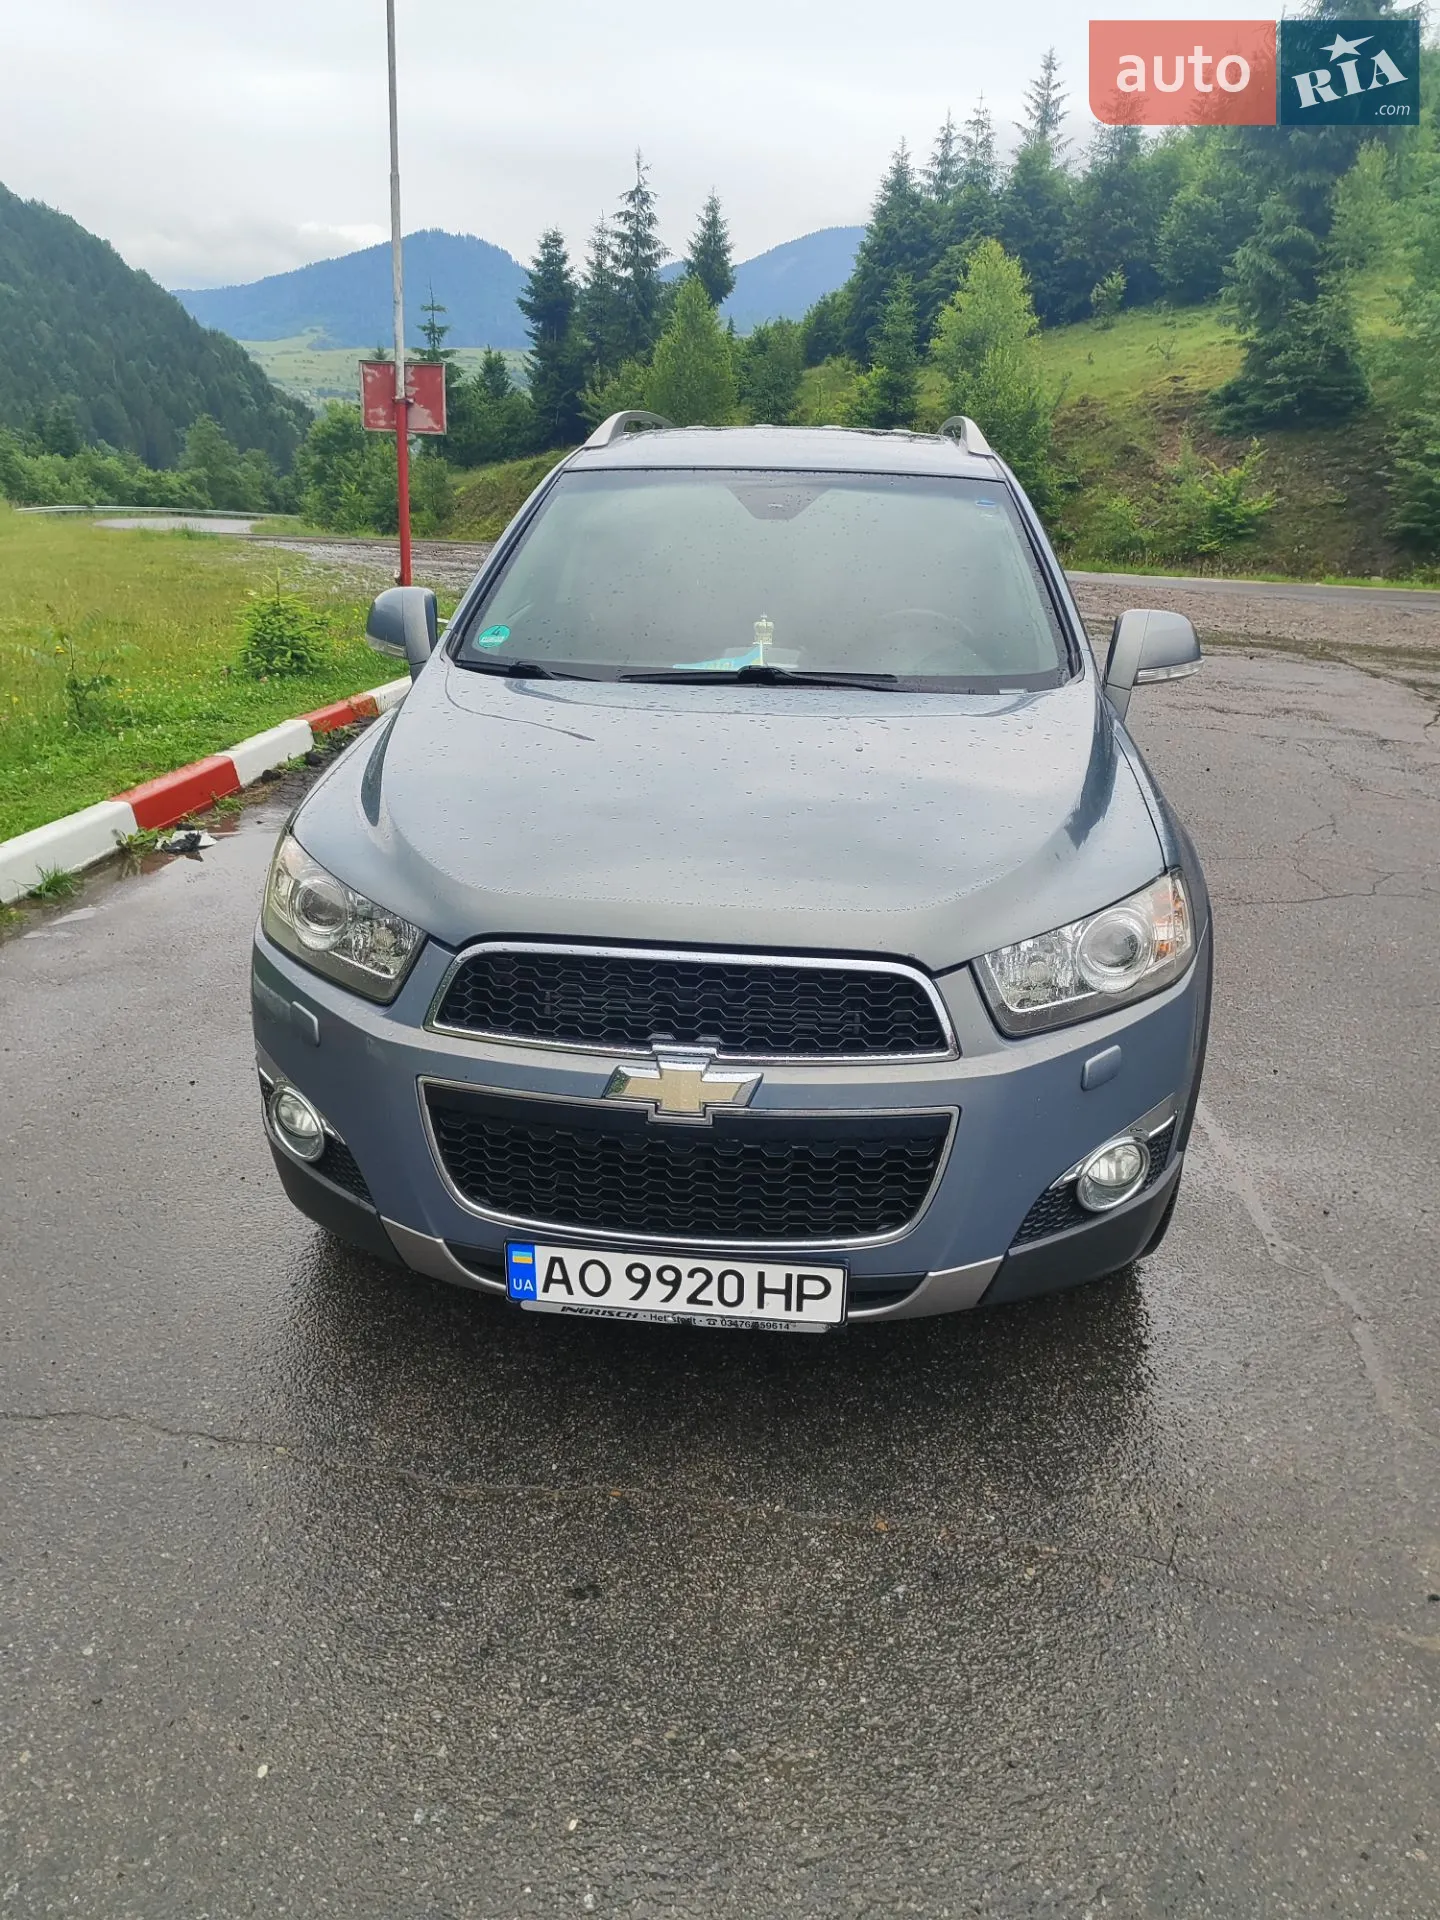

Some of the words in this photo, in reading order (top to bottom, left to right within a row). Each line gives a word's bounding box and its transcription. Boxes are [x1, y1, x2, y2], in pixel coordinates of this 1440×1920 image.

[513, 1278, 534, 1291] UA
[541, 1256, 612, 1298] AO
[625, 1262, 745, 1308] 9920
[757, 1271, 832, 1312] HP
[560, 1305, 639, 1319] INGRISCH
